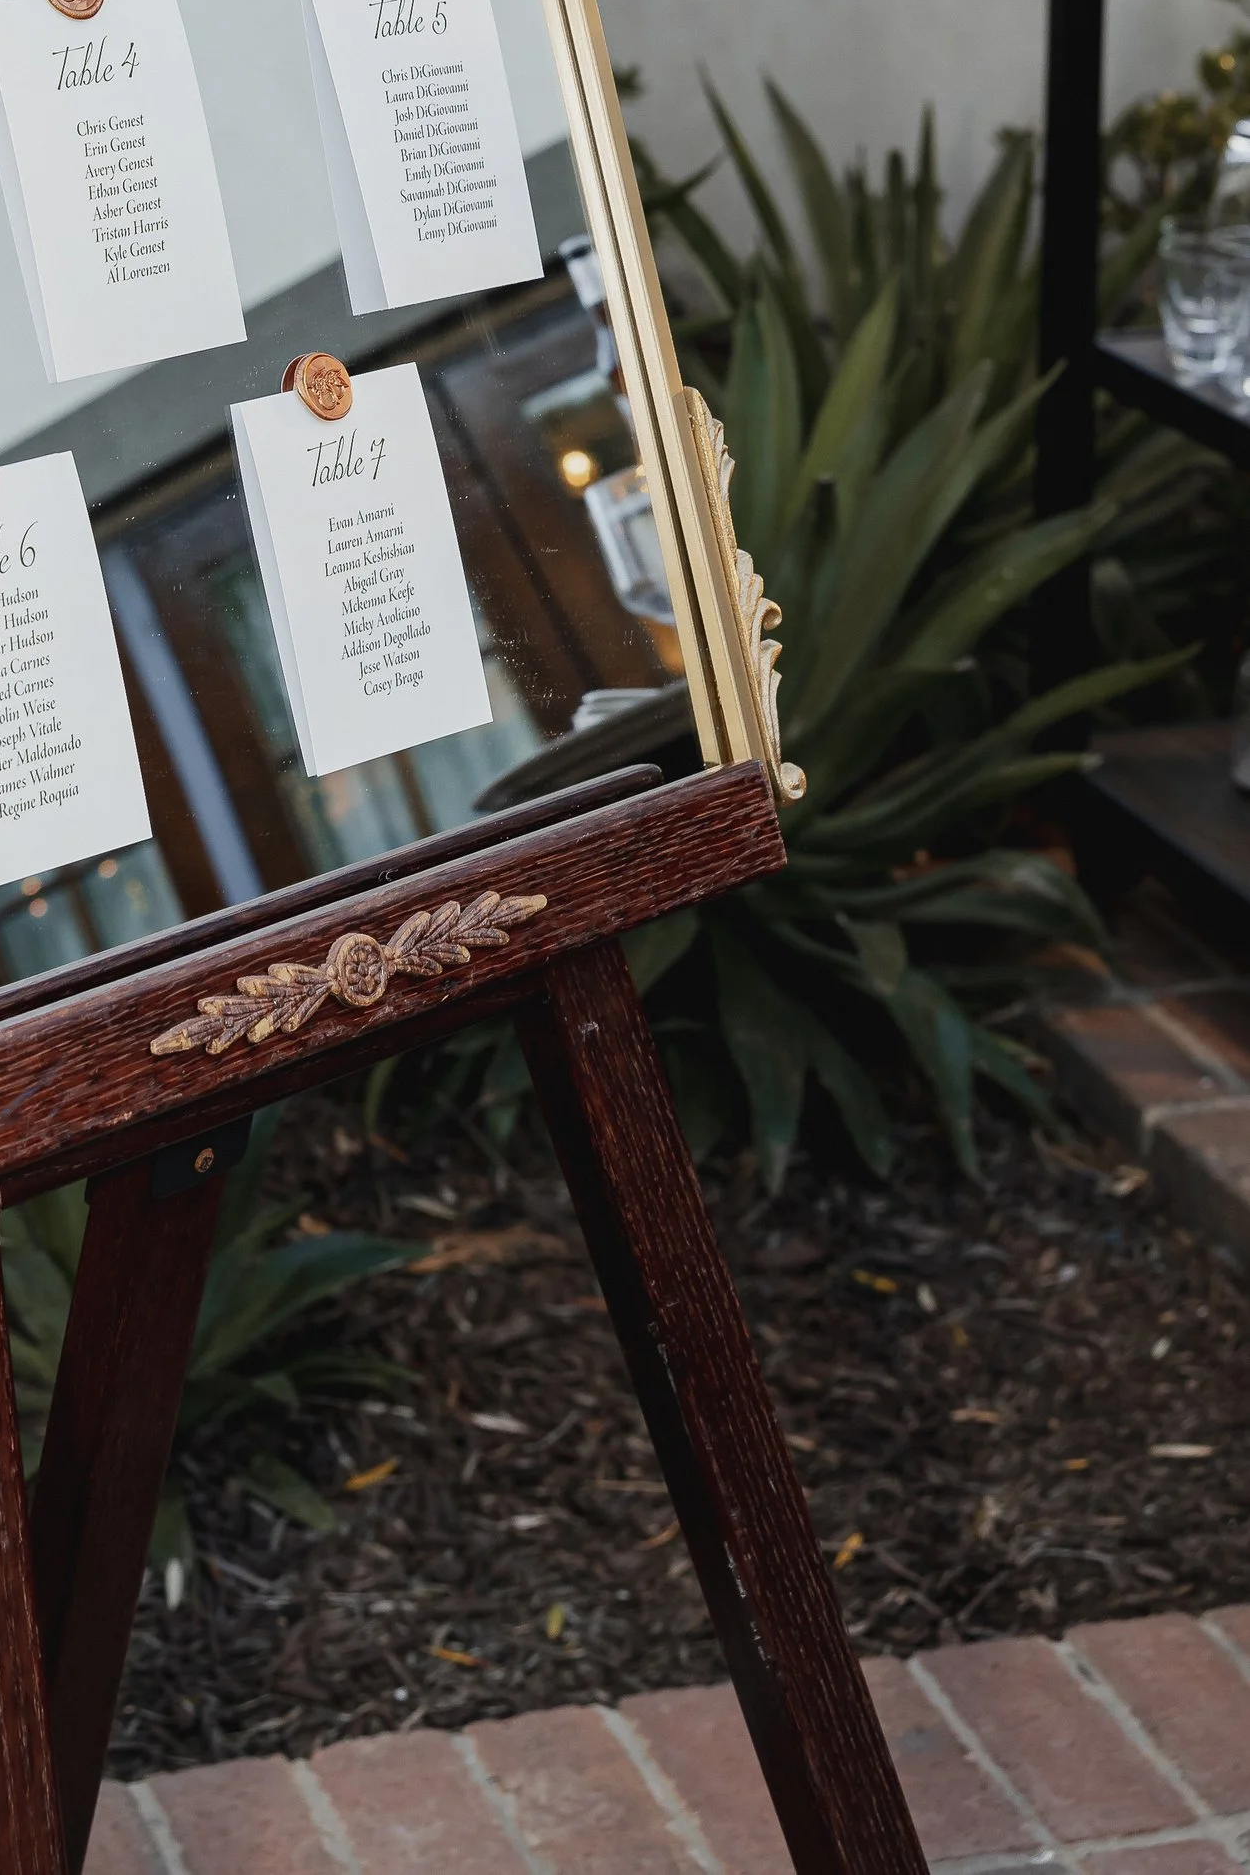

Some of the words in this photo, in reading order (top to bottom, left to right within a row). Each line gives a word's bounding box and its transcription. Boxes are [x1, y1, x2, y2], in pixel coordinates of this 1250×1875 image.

[431, 0, 448, 35] 5
[51, 35, 115, 91] Table
[121, 41, 141, 79] 4
[381, 68, 409, 85] Chris
[409, 60, 464, 80] DiGiovanni
[384, 89, 415, 104] Laura
[415, 79, 469, 100] DiGiovanni
[76, 119, 107, 137] Chris
[108, 113, 144, 131] Genest
[84, 141, 108, 158] Erin
[109, 134, 146, 153] Genest
[84, 163, 116, 181] Avery
[118, 155, 154, 173] Genest
[87, 182, 120, 201] Ethan
[122, 176, 158, 194] Genest
[399, 178, 445, 204] Savannah
[445, 174, 497, 196] DiGiovanni
[92, 202, 124, 222] Asher
[126, 196, 161, 215] Genest
[413, 204, 442, 226] Dylan
[442, 195, 494, 217] DiGiovanni
[91, 226, 131, 244] Tristan
[133, 216, 169, 236] Harris
[417, 227, 446, 243] Lenny
[447, 214, 498, 237] DiGiovanni
[104, 244, 128, 268] Kyle
[129, 239, 165, 258] Genest
[106, 266, 120, 285] Al
[121, 262, 171, 282] Lorenzen
[306, 427, 365, 488] Table
[369, 436, 388, 481] 7
[328, 516, 354, 533] Evan
[356, 502, 395, 526] Amarni
[19, 520, 39, 568] 6
[327, 536, 363, 555] Lauren
[365, 521, 404, 545] Amarni
[324, 558, 361, 578] Leanna
[362, 542, 415, 567] Keshishian
[343, 569, 378, 595] Abigail
[379, 567, 405, 584] Gray
[388, 580, 415, 604] Keefe
[4, 607, 49, 631] Hudson
[343, 615, 374, 638] Micky
[9, 629, 54, 652] Hudson
[341, 638, 381, 660] Addison
[383, 620, 431, 649] Degollado
[9, 654, 51, 675] Carnes
[358, 661, 381, 681] Jesse
[382, 649, 420, 669] Watson
[13, 676, 55, 697] Carnes
[363, 679, 393, 696] Casey
[394, 670, 424, 688] Braga
[22, 698, 56, 717] Weise
[28, 716, 63, 738] Vitale
[16, 733, 82, 767] Maldonado
[29, 763, 76, 786] Walmer
[39, 783, 79, 807] Roquia
